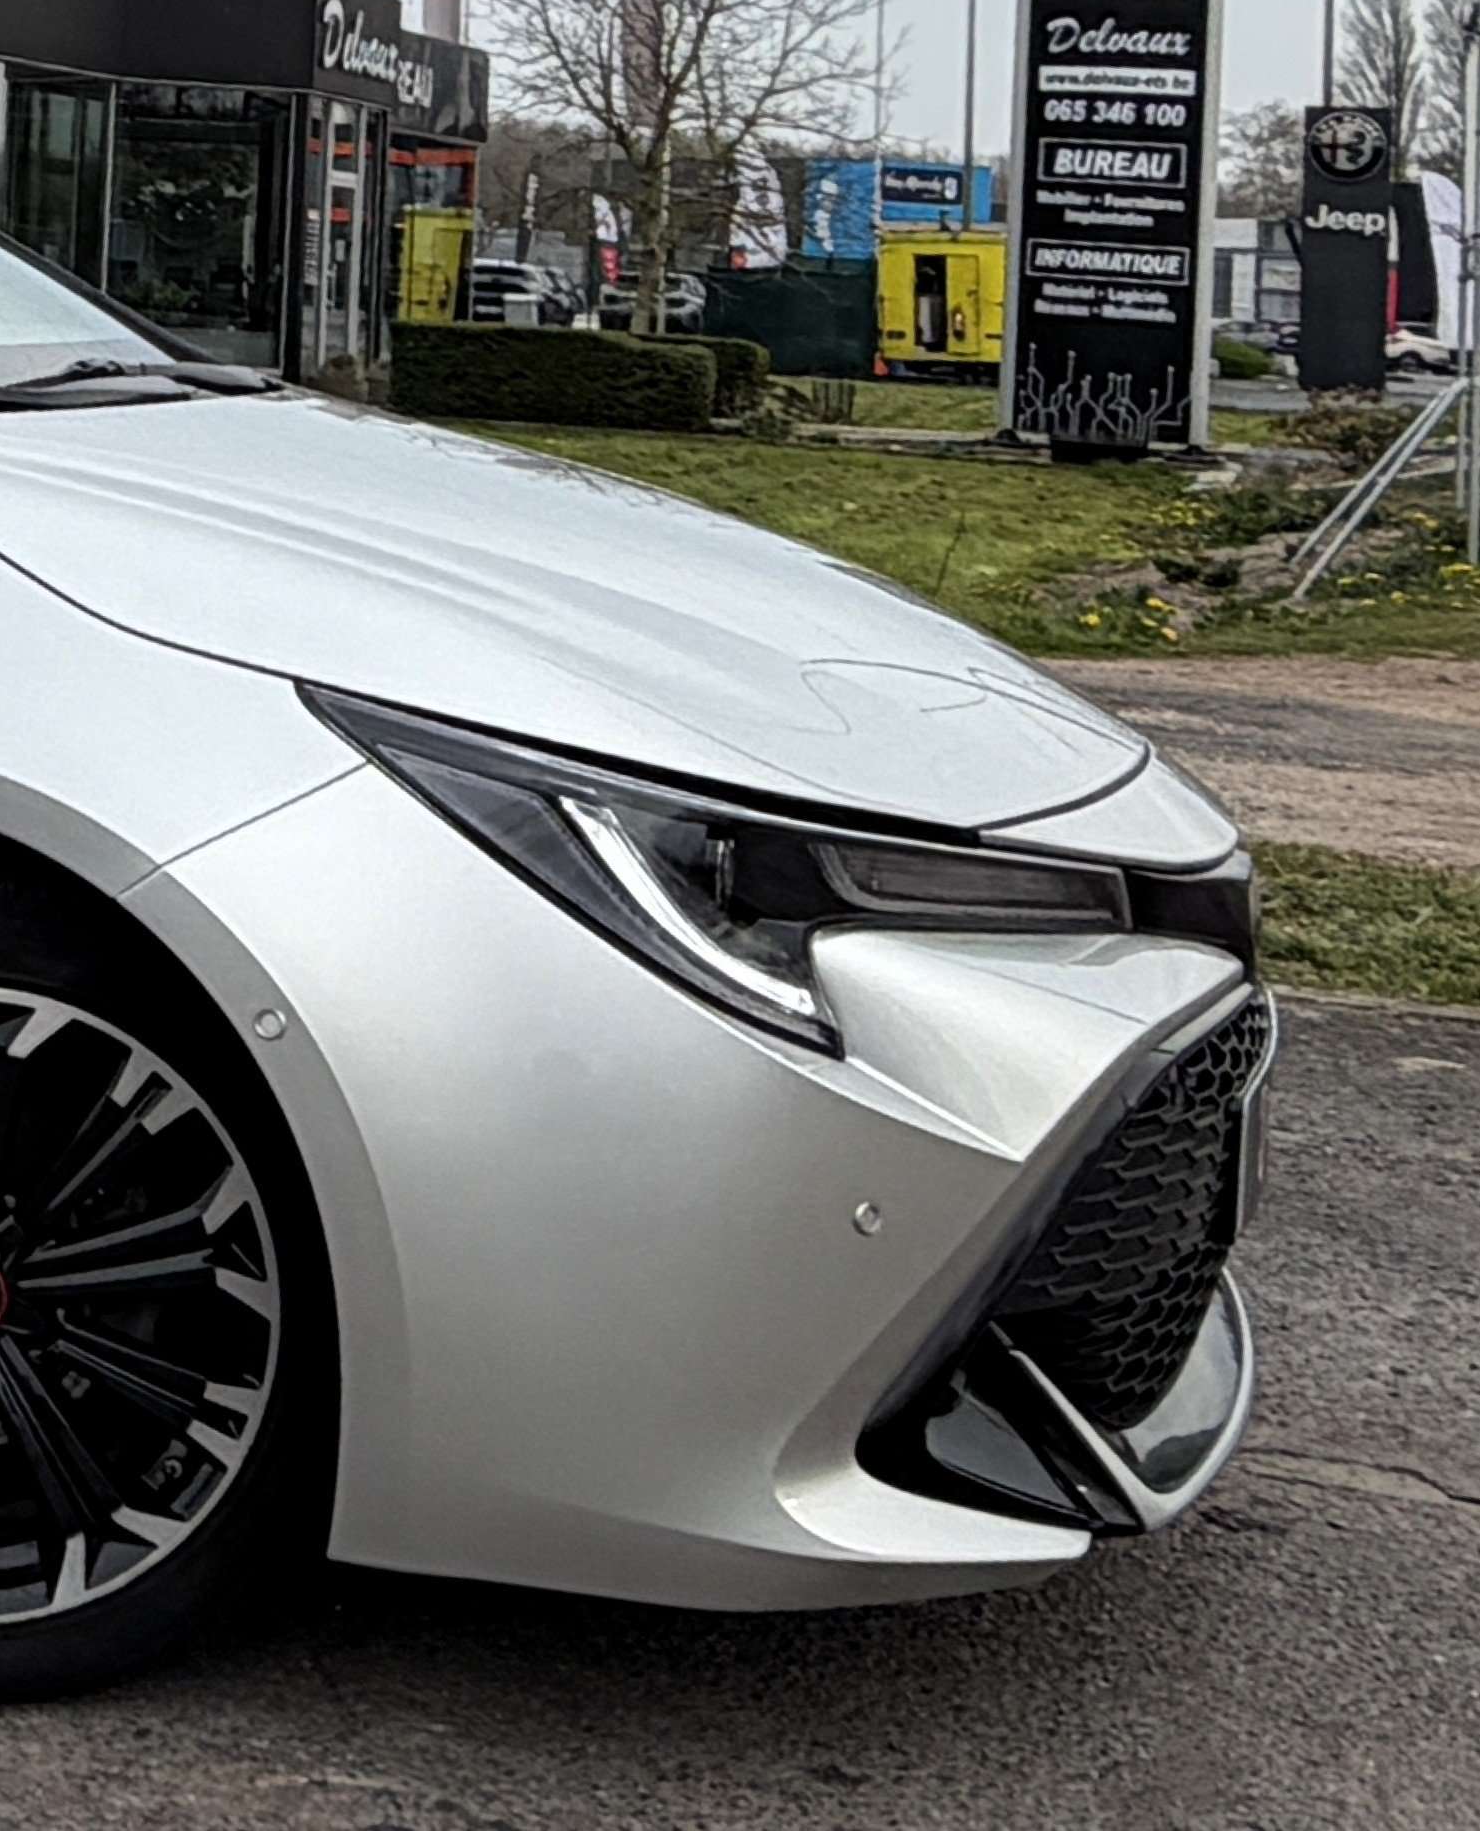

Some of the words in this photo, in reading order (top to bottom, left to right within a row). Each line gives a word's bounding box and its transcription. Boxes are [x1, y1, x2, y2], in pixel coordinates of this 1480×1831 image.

[1046, 17, 1191, 56] Delvaux
[1043, 98, 1088, 122] 065
[1144, 103, 1187, 126] 100
[1052, 147, 1172, 179] BUREAU
[1304, 204, 1385, 236] Jeep
[1034, 247, 1182, 276] INFORMATIQUE
